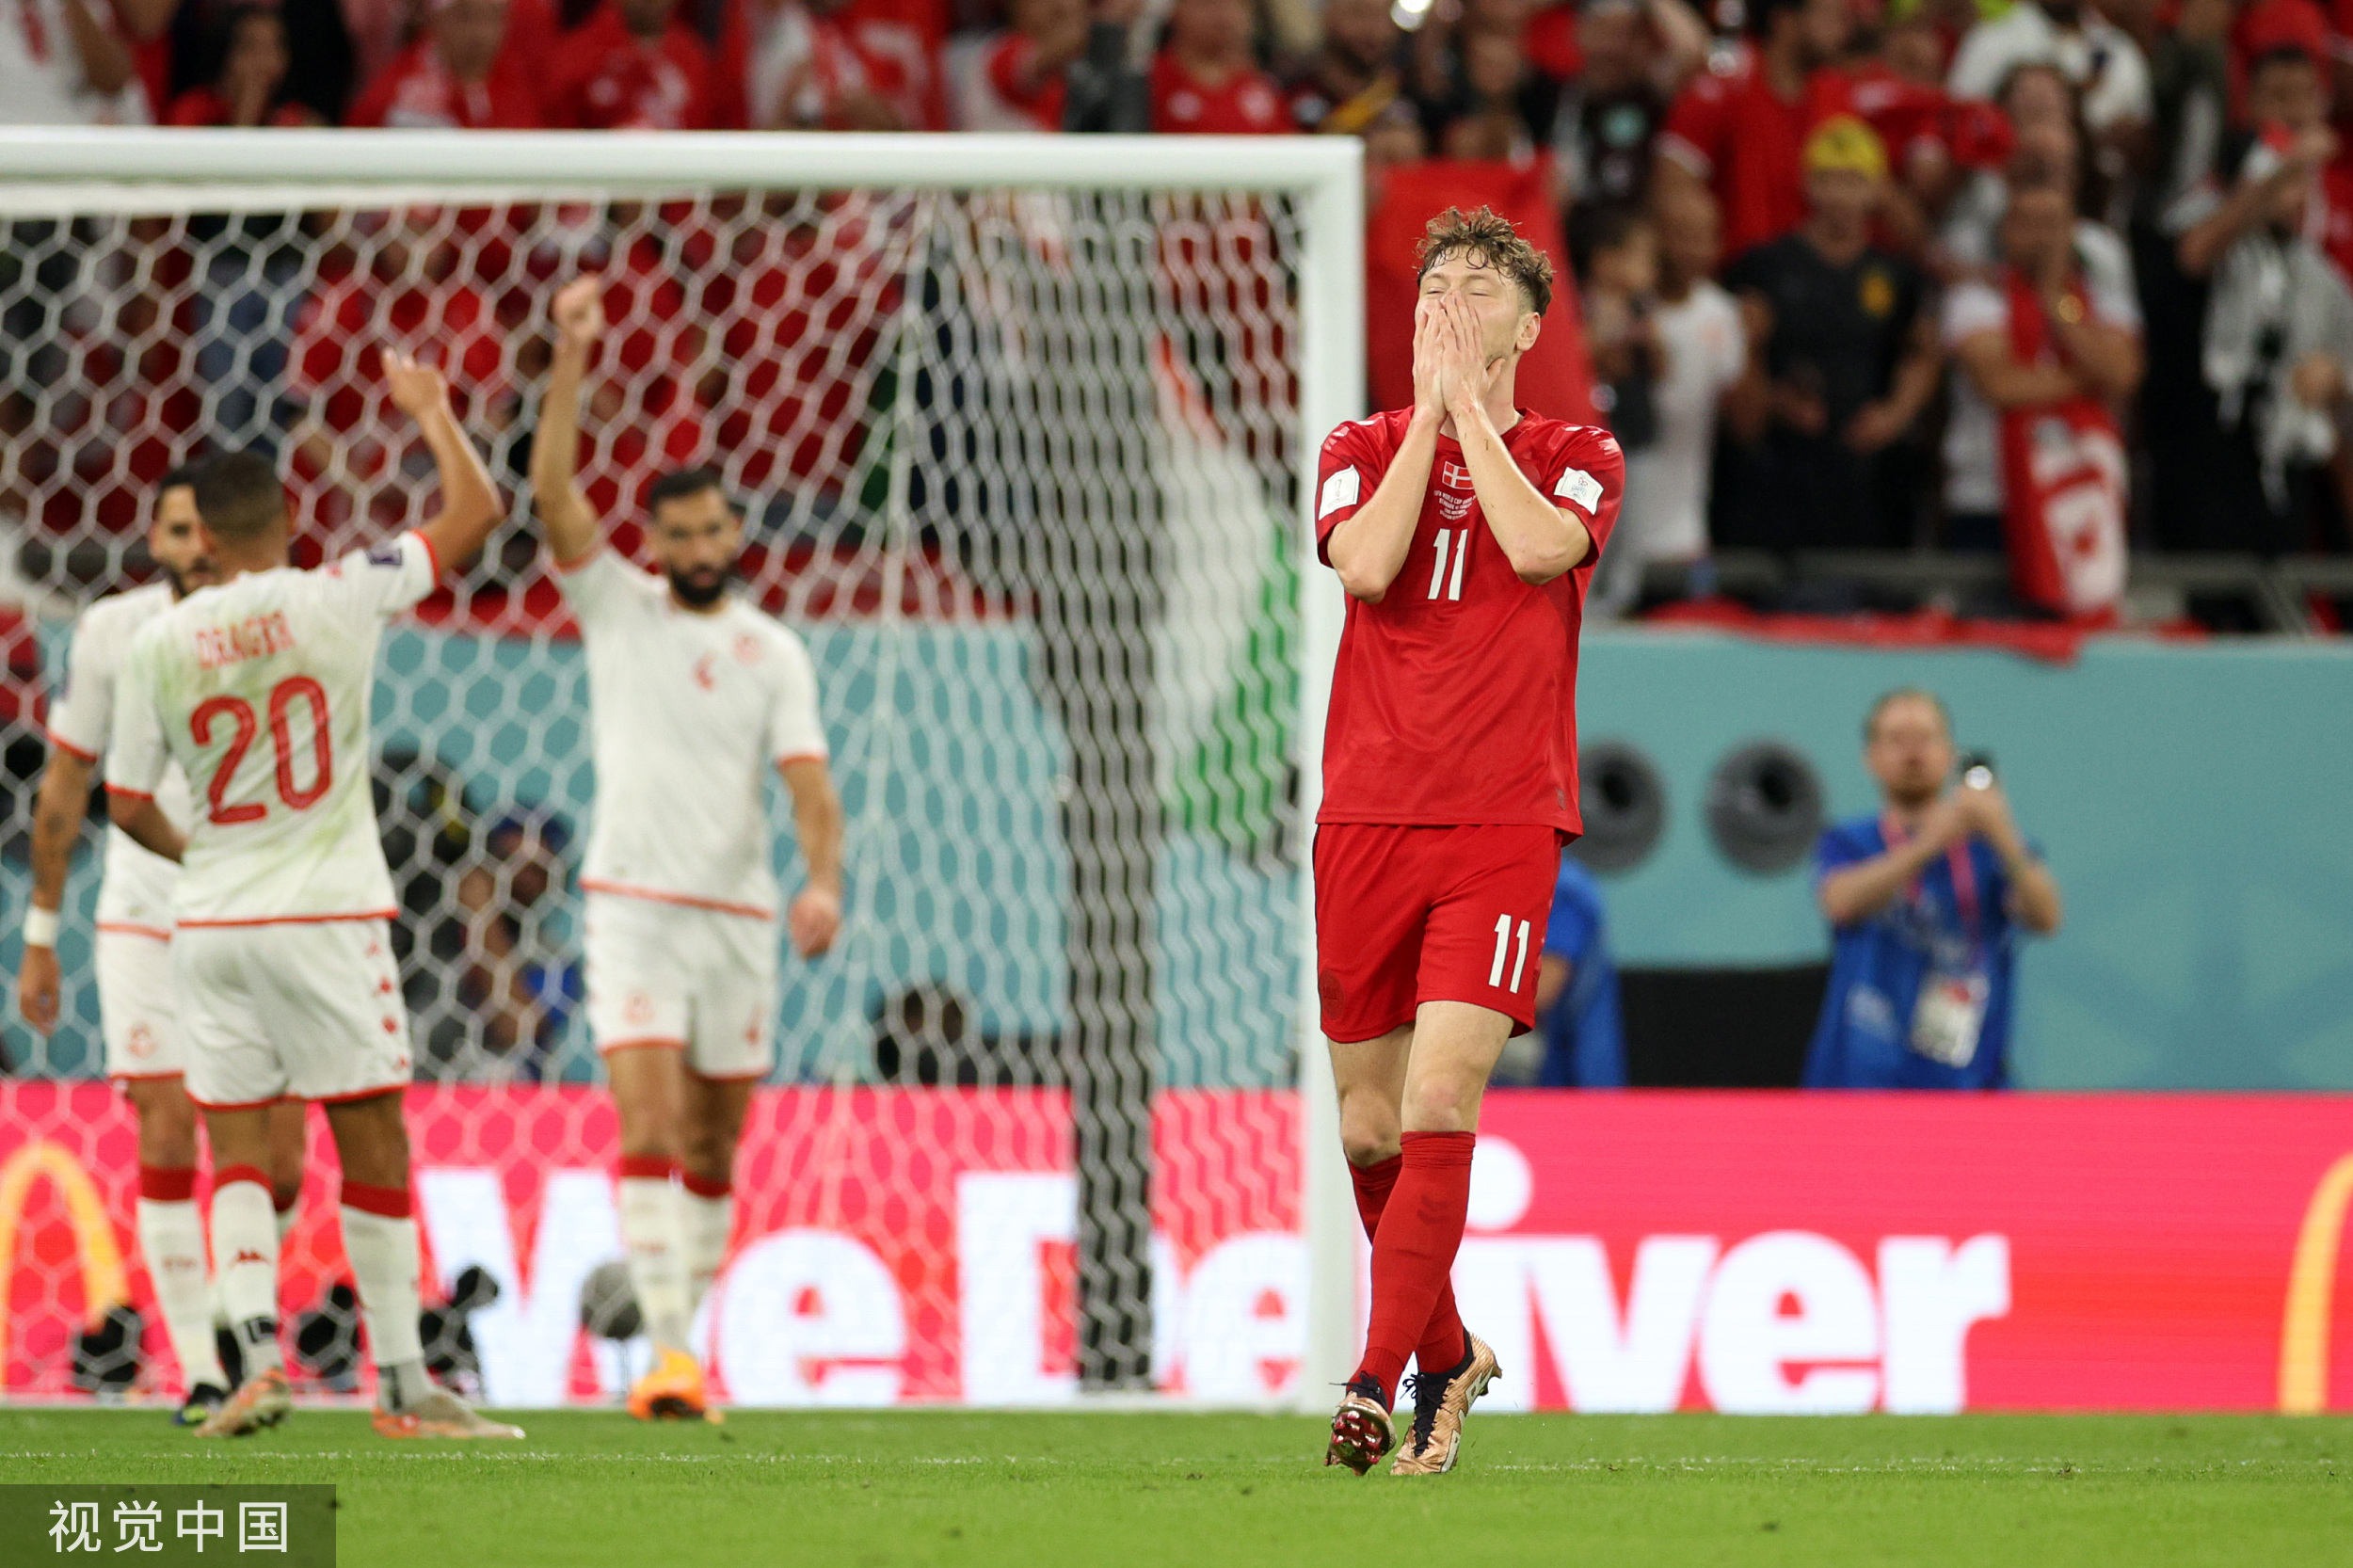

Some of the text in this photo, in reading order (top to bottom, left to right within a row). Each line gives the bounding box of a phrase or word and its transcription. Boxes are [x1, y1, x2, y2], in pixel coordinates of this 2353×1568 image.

[1427, 528, 1468, 600] 11
[190, 674, 333, 826] 20
[1488, 913, 1530, 994] 11
[414, 1135, 2010, 1415] We Deiver
